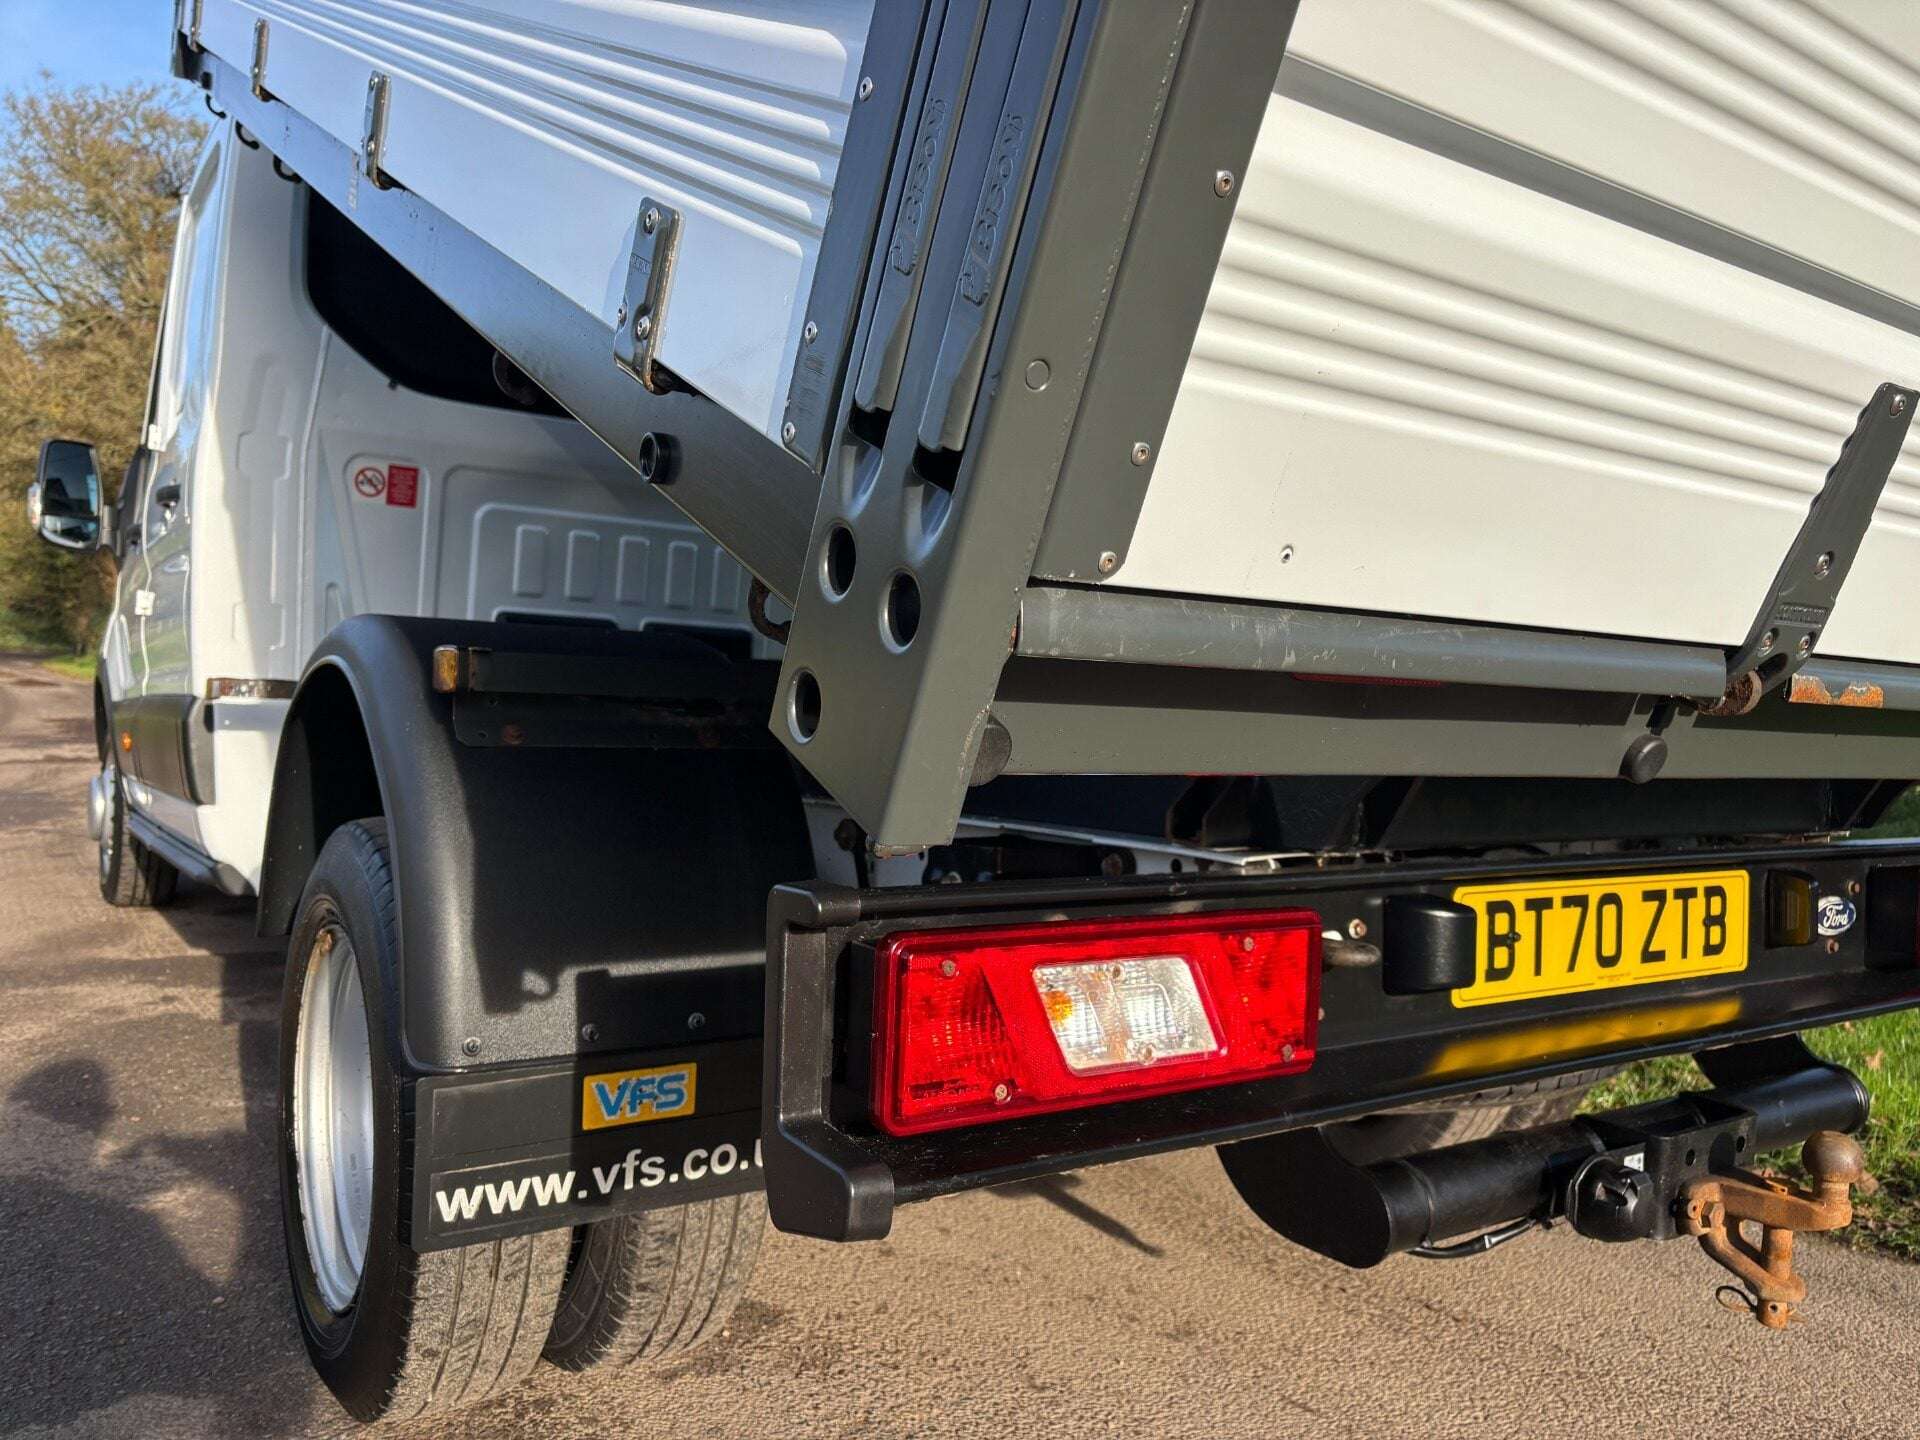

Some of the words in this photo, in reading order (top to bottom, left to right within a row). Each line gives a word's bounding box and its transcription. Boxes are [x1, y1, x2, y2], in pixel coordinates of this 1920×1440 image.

[1485, 892, 1624, 983] BT70
[1640, 885, 1728, 964] ZTB
[1823, 904, 1850, 927] Ford
[592, 1070, 689, 1120] VFS
